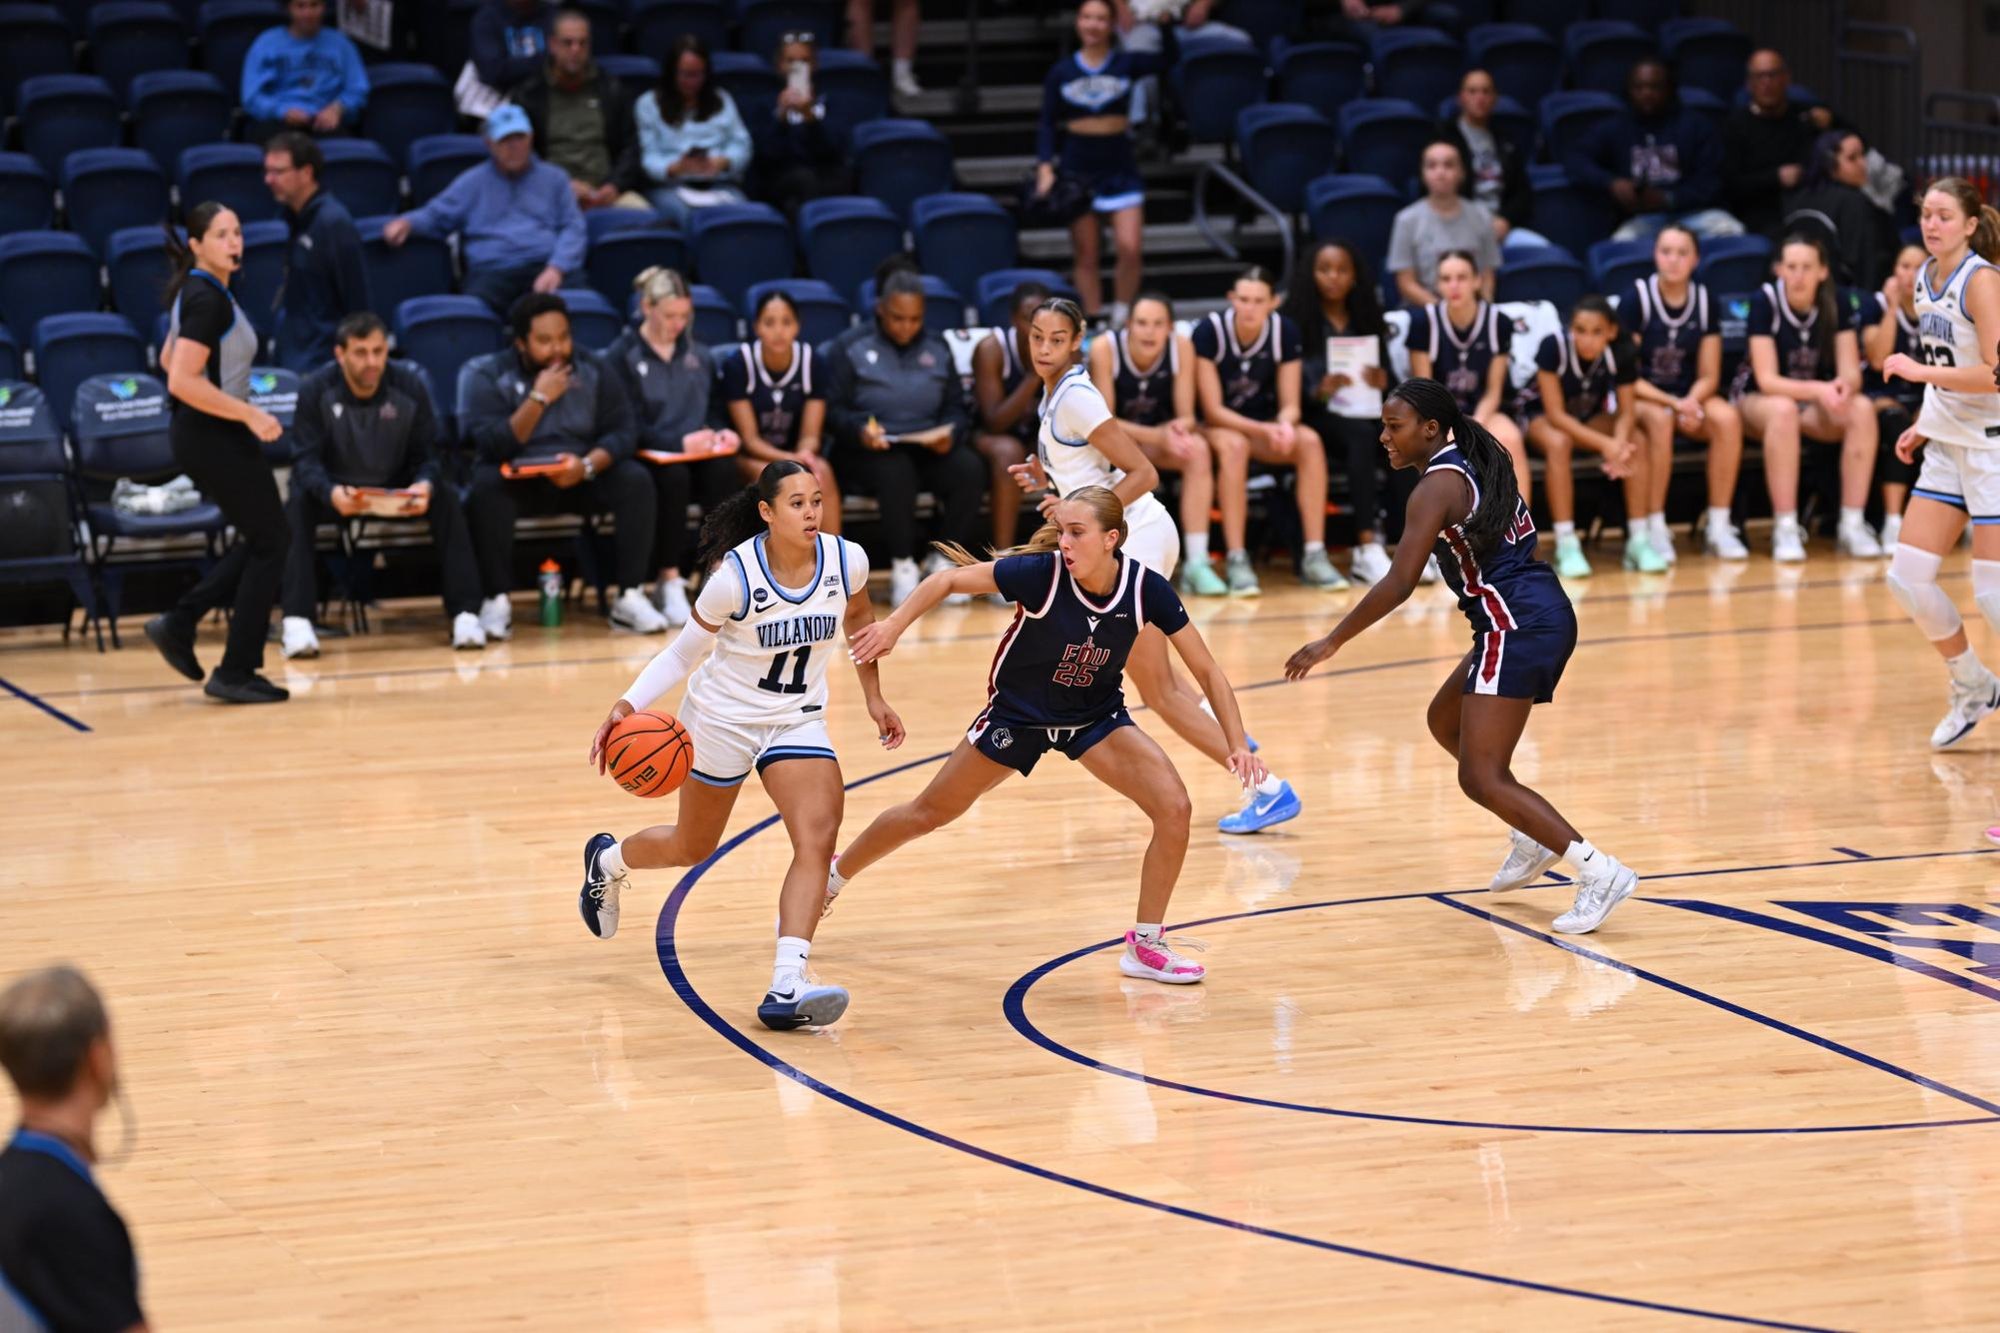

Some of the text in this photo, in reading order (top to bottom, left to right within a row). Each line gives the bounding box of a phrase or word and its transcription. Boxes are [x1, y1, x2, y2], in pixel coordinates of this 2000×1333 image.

[756, 615, 838, 649] VILLANOVA
[1062, 642, 1111, 666] FDU
[757, 645, 812, 694] 11
[1052, 661, 1099, 688] 25
[620, 764, 659, 792] ELITE
